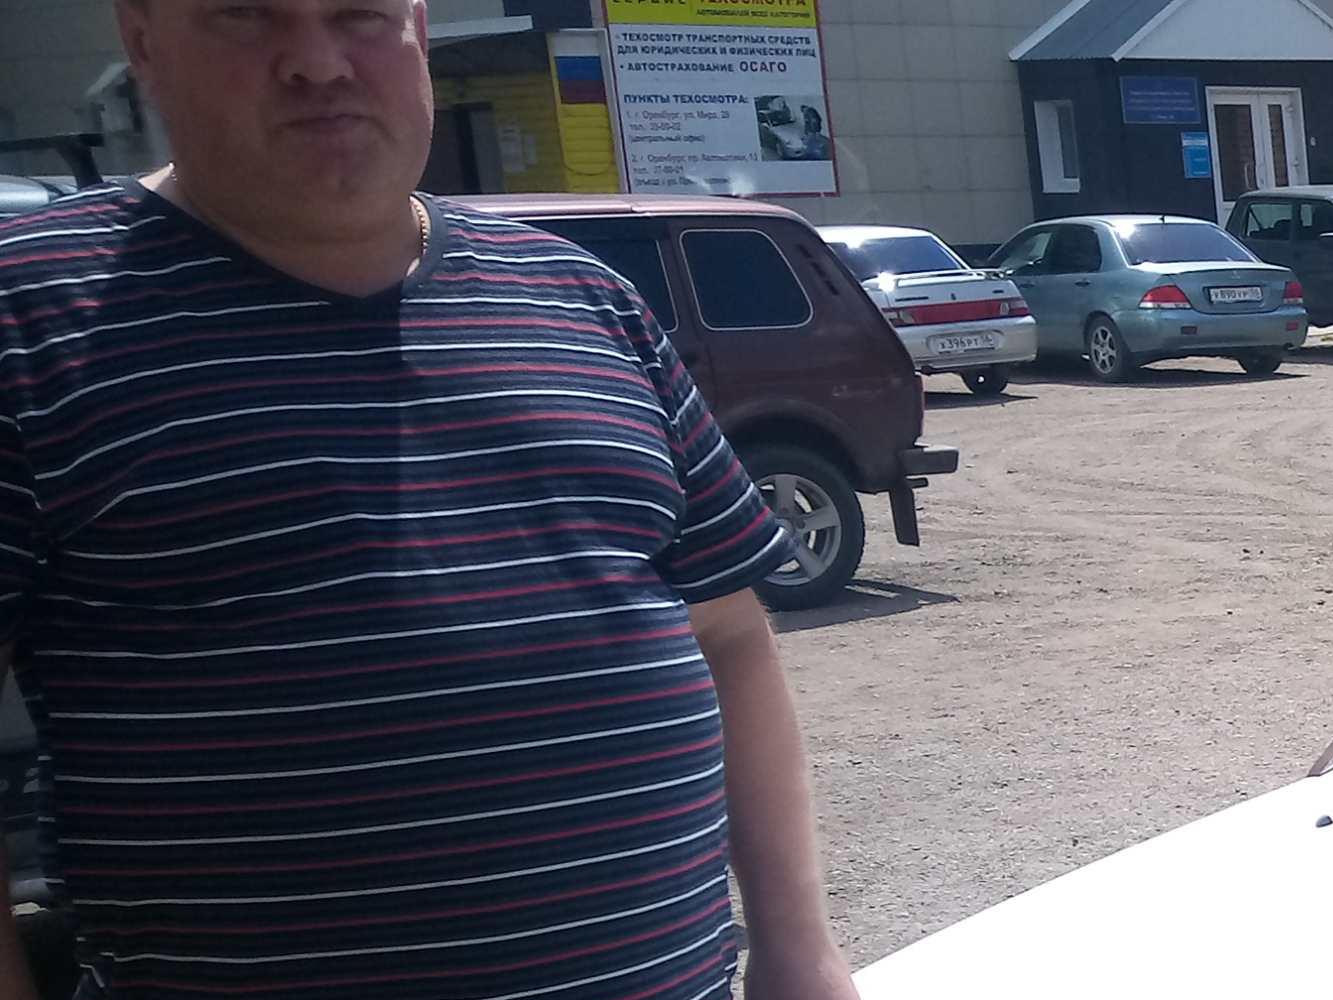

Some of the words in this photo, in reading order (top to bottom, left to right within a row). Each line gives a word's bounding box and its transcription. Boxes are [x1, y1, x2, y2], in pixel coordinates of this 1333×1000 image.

[621, 33, 684, 41] ТЕХОСМОТР
[686, 33, 766, 44] ТРАНСПОРТНЫХ
[768, 35, 811, 45] СРЕДСТВ
[617, 45, 638, 55] ДЛЯ
[641, 46, 717, 55] ЮРИДИЧЕСКИХ
[719, 47, 727, 55] И
[729, 47, 793, 56] ФИЗИЧЕСКИХ
[795, 48, 816, 57] ЛИЦ
[627, 62, 735, 72] АВТОСТРАХОВАНИЕ
[739, 61, 787, 72] ОСАГО
[624, 94, 669, 103] ПУНКТЫ
[672, 94, 748, 104] ТЕХОСМОТРА:
